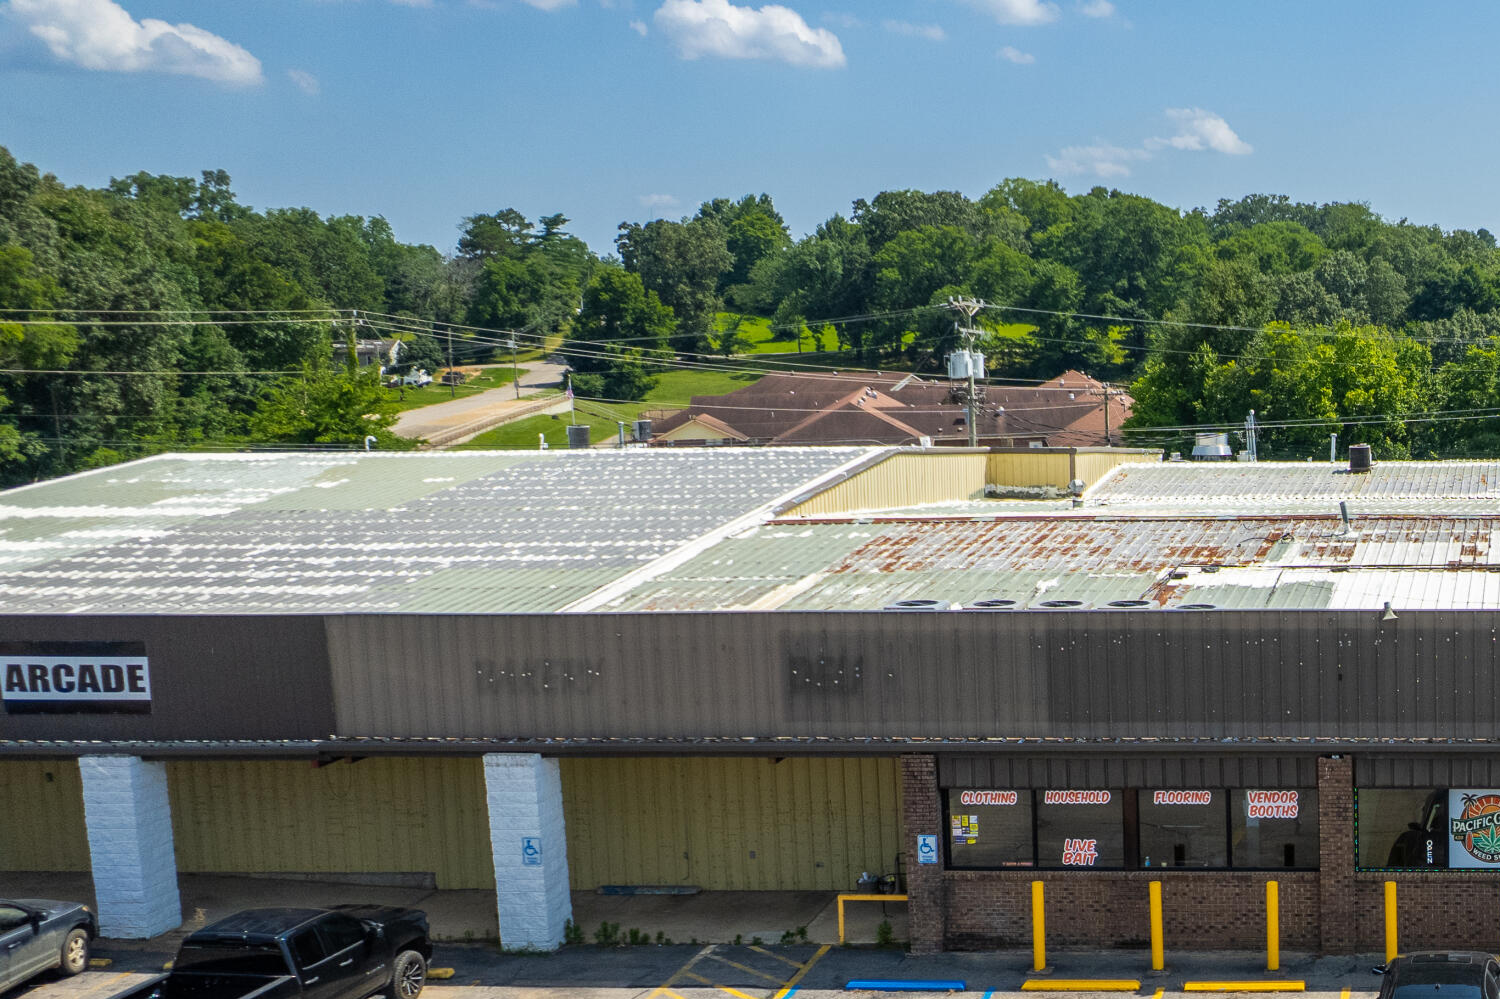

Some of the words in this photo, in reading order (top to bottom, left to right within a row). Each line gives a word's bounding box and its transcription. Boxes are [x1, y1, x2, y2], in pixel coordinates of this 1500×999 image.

[5, 663, 147, 693] ARCADE
[961, 791, 1017, 804] CLOTHING
[1045, 791, 1111, 804] HOUSEHOLD
[1154, 791, 1211, 804] FLOORING
[1248, 791, 1298, 804] VENDOR
[1248, 804, 1299, 818] BOOTHS
[1453, 817, 1493, 833] PACIFIC
[1064, 839, 1097, 852] LIVE
[1063, 852, 1098, 866] BAIT
[1472, 847, 1492, 860] WEED
